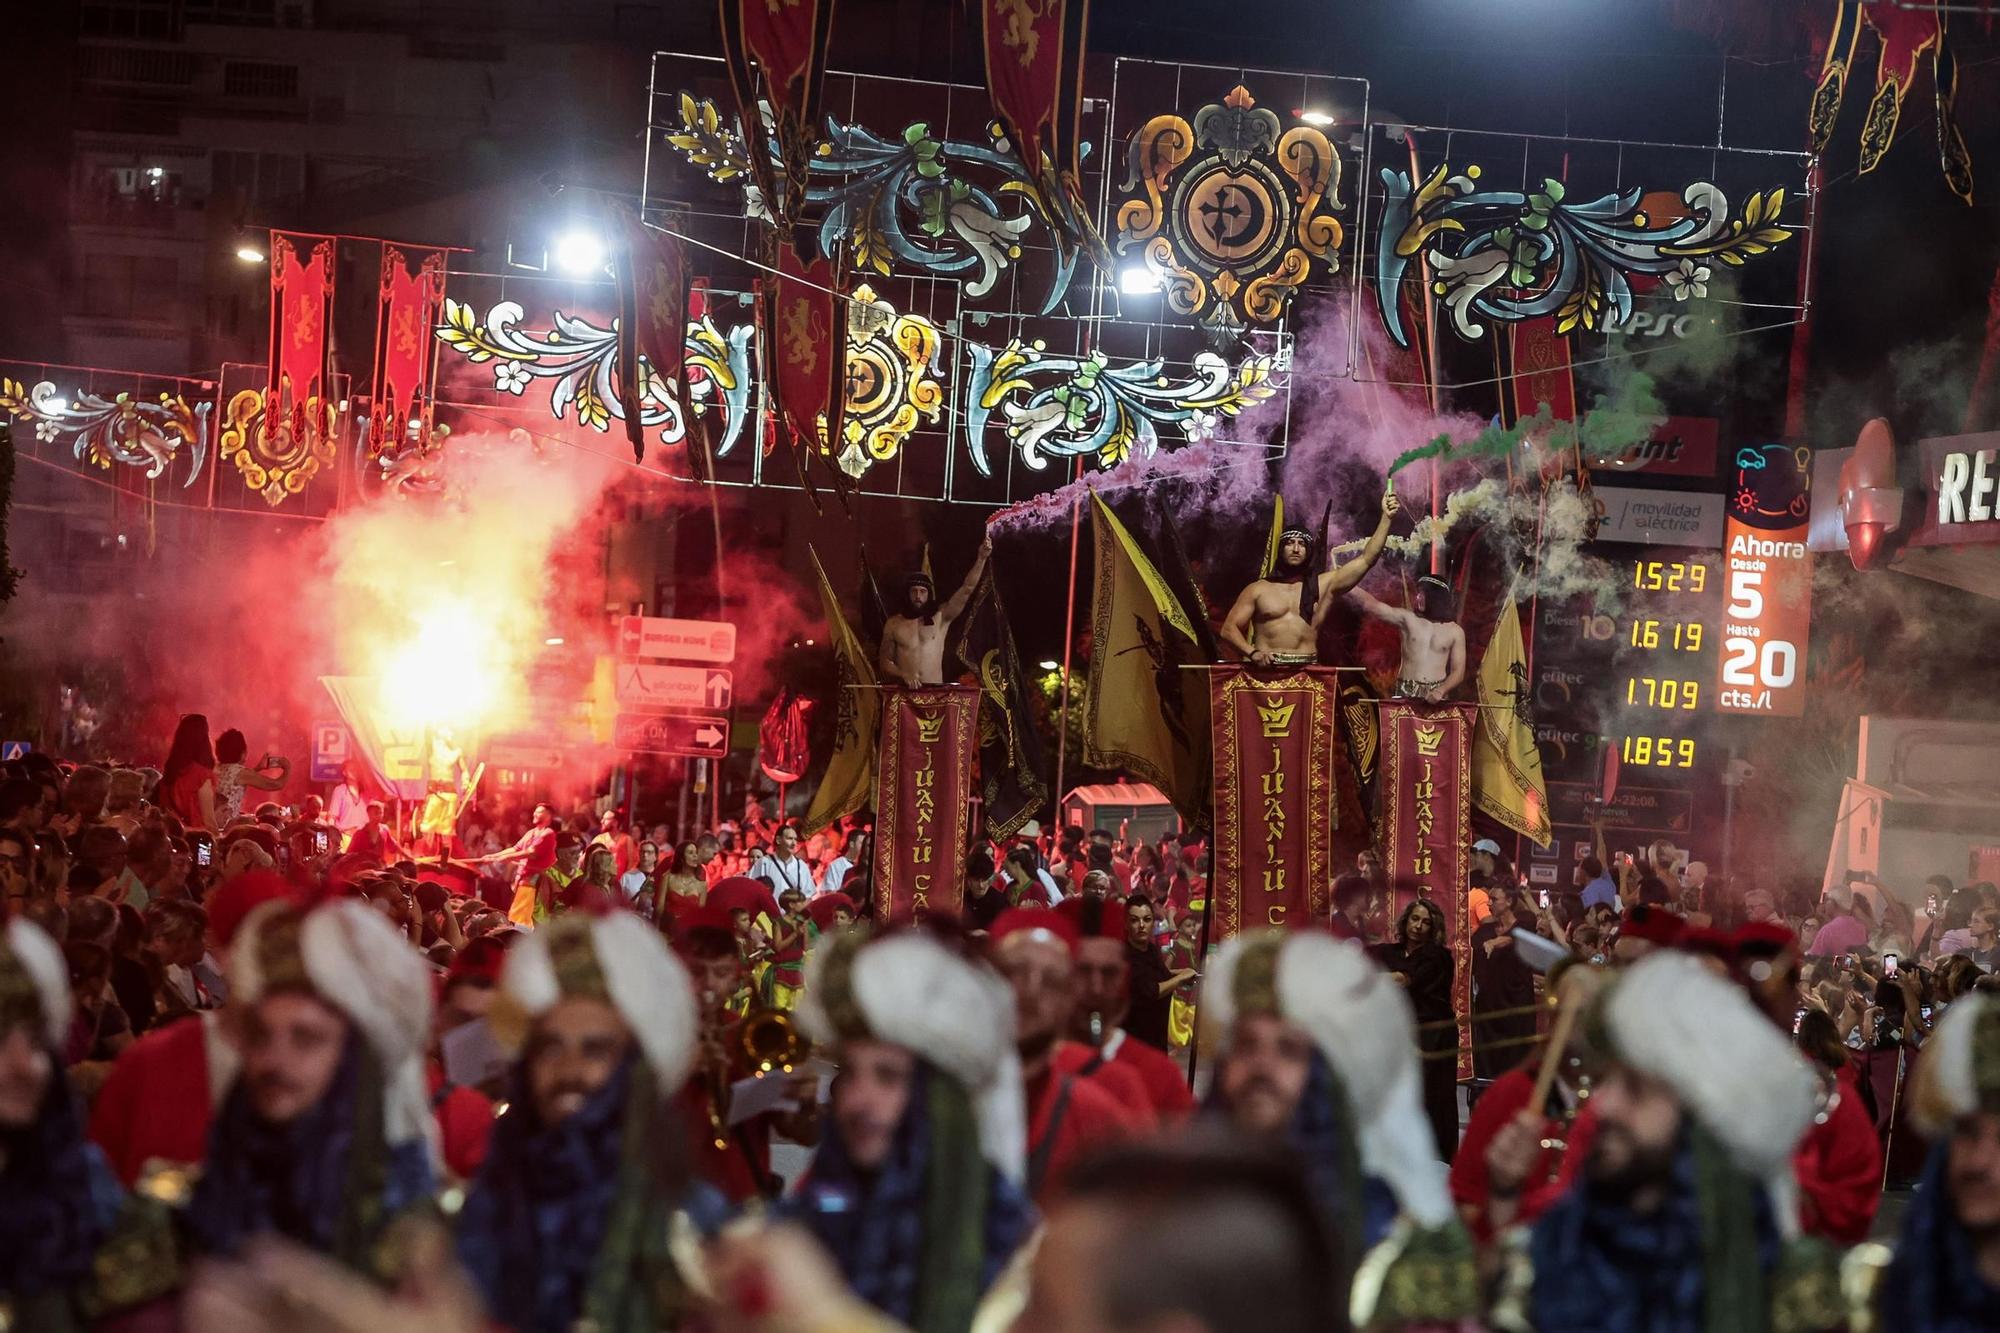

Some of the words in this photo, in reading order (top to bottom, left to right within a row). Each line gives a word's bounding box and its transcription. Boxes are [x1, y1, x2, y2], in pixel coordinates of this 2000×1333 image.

[1939, 450, 2000, 524] RE
[1632, 502, 1701, 518] movilidad
[1731, 535, 1804, 559] Ahorra
[1635, 561, 1706, 592] 1.529
[1731, 558, 1766, 571] Desde
[1728, 571, 1763, 619] 5
[1545, 613, 1579, 626] Diesel
[1580, 614, 1615, 640] 10
[1726, 624, 1760, 637] Hasta
[1723, 638, 1796, 688] 20
[1628, 678, 1698, 710] 1.709
[323, 730, 340, 752] P
[1624, 736, 1694, 768] 1.859
